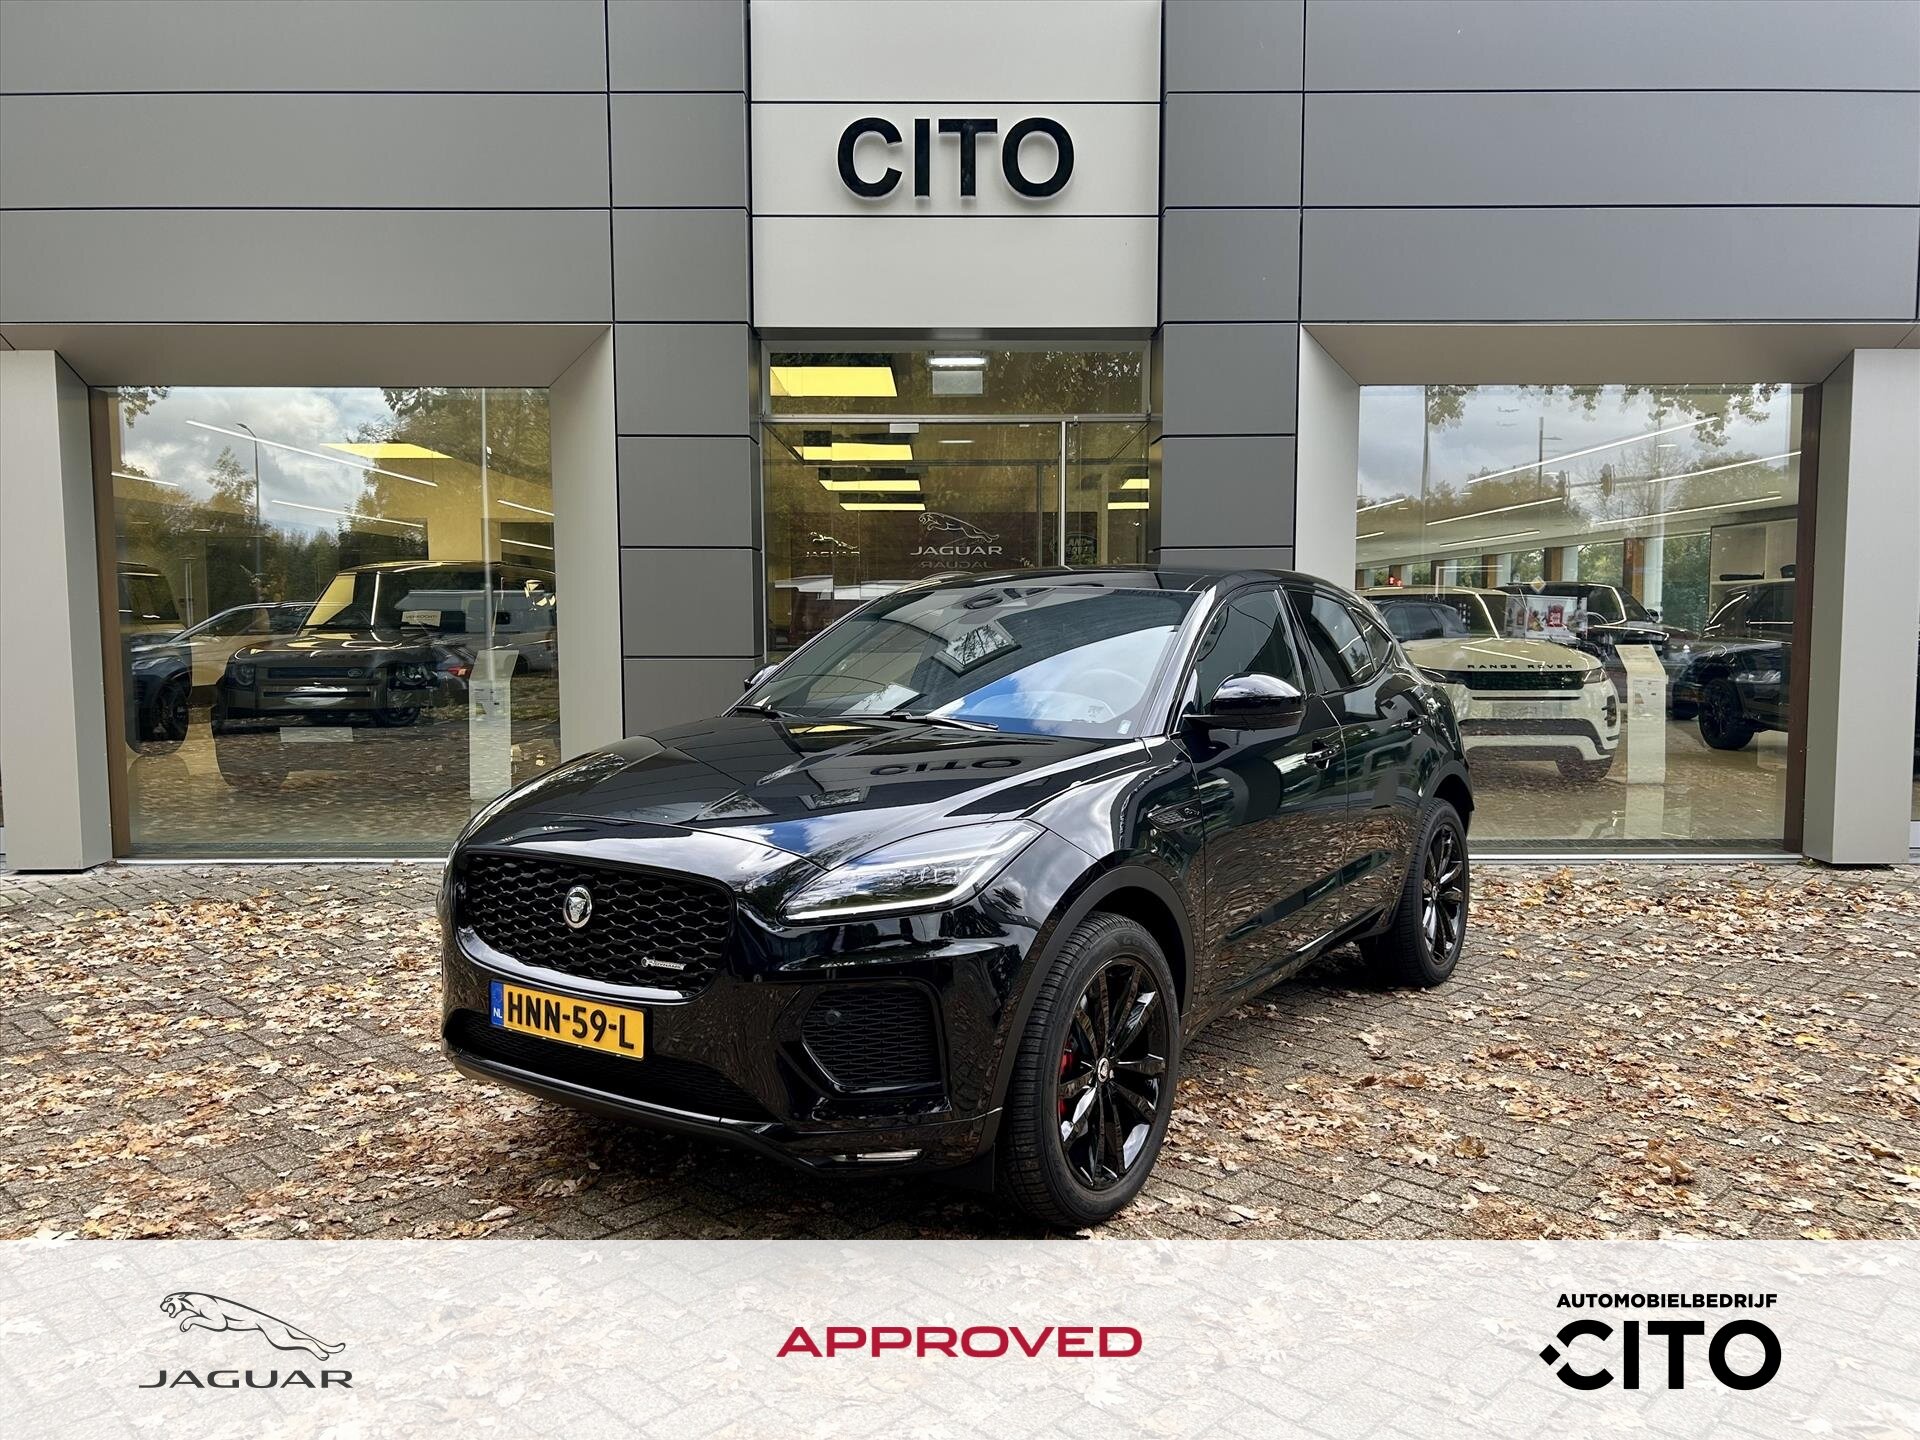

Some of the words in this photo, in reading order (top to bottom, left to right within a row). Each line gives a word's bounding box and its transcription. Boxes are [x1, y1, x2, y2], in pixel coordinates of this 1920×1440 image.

[837, 116, 1075, 198] CITO
[910, 545, 1003, 556] JAGUAR
[493, 1007, 503, 1019] NL
[507, 991, 635, 1050] HNN-59-L
